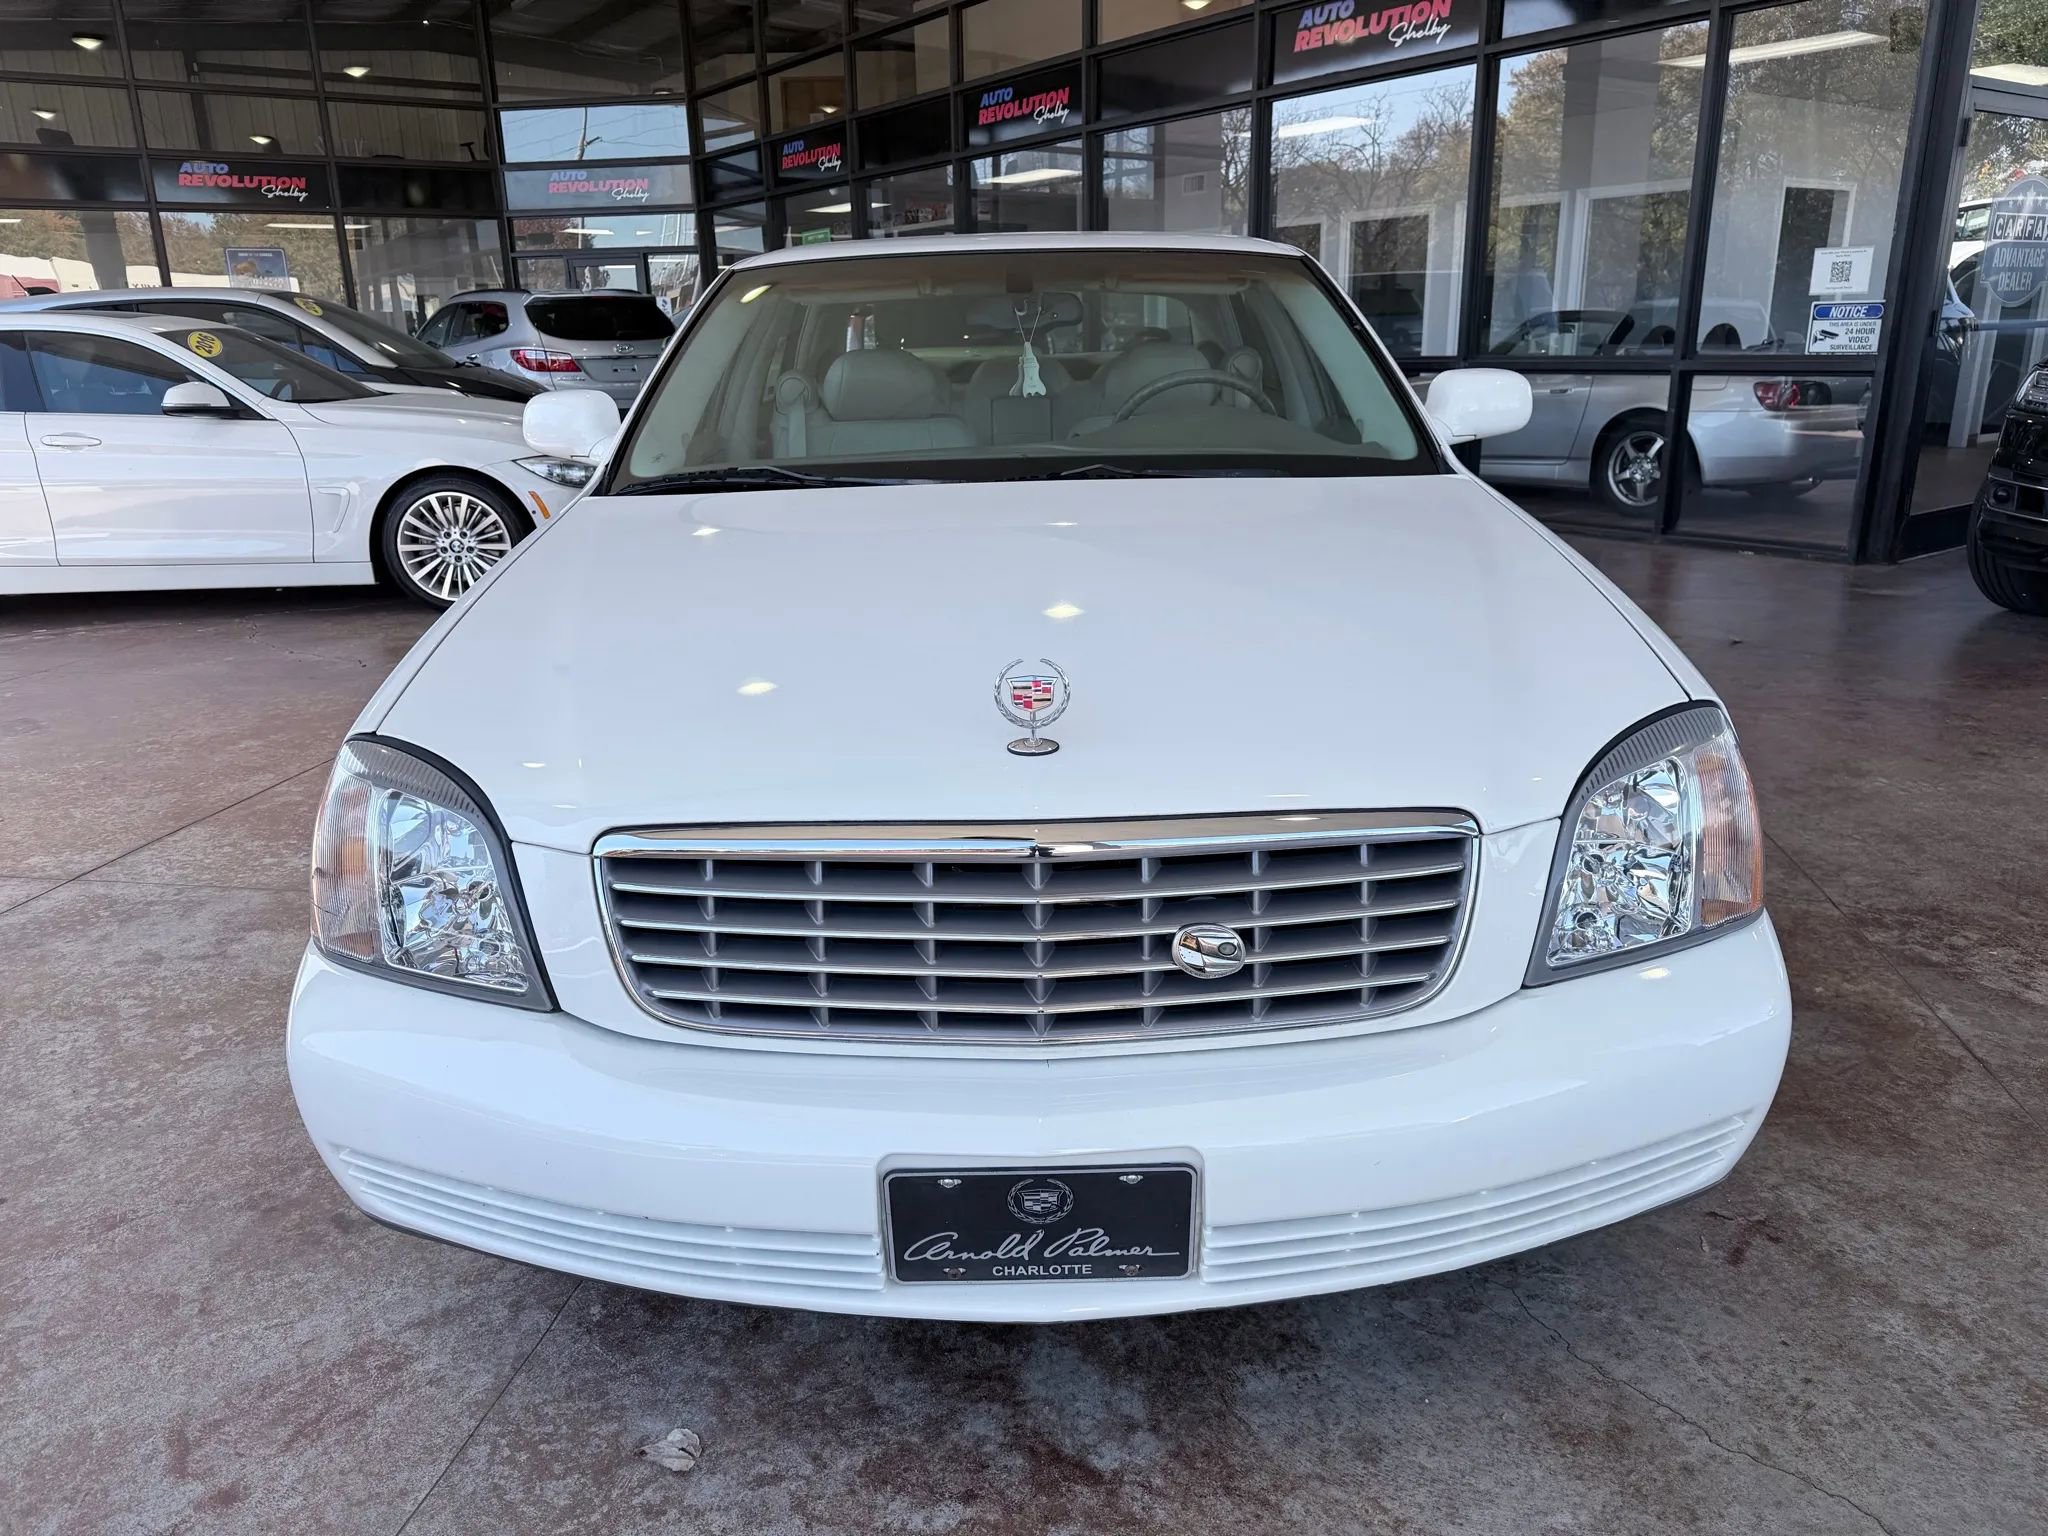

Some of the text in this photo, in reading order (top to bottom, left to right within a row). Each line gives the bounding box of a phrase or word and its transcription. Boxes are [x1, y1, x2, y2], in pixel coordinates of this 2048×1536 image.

[1298, 0, 1355, 28] AUTO
[1294, 0, 1452, 52] REVOLUTION
[1388, 14, 1451, 48] Shelby
[978, 87, 1070, 125] REVOLUTION
[980, 87, 1013, 107] AUTO
[1033, 101, 1070, 124] Shelby
[782, 143, 841, 170] REVOLUTION
[783, 140, 804, 155] AUTO
[179, 162, 229, 174] AUTO
[818, 153, 842, 172] Shelby
[178, 174, 307, 189] REVOLUTION
[550, 171, 587, 181] AUTO
[261, 185, 308, 202] Shelby
[549, 179, 649, 193] REVOLUTION
[611, 187, 650, 202] Shelby
[1992, 247, 2046, 268] ADVANTAGE
[1997, 272, 2033, 291] DEALER
[1829, 305, 1869, 318] NOTICE
[903, 1227, 1180, 1261] Arnold Palmer
[992, 1264, 1093, 1277] CHARLOTTE
